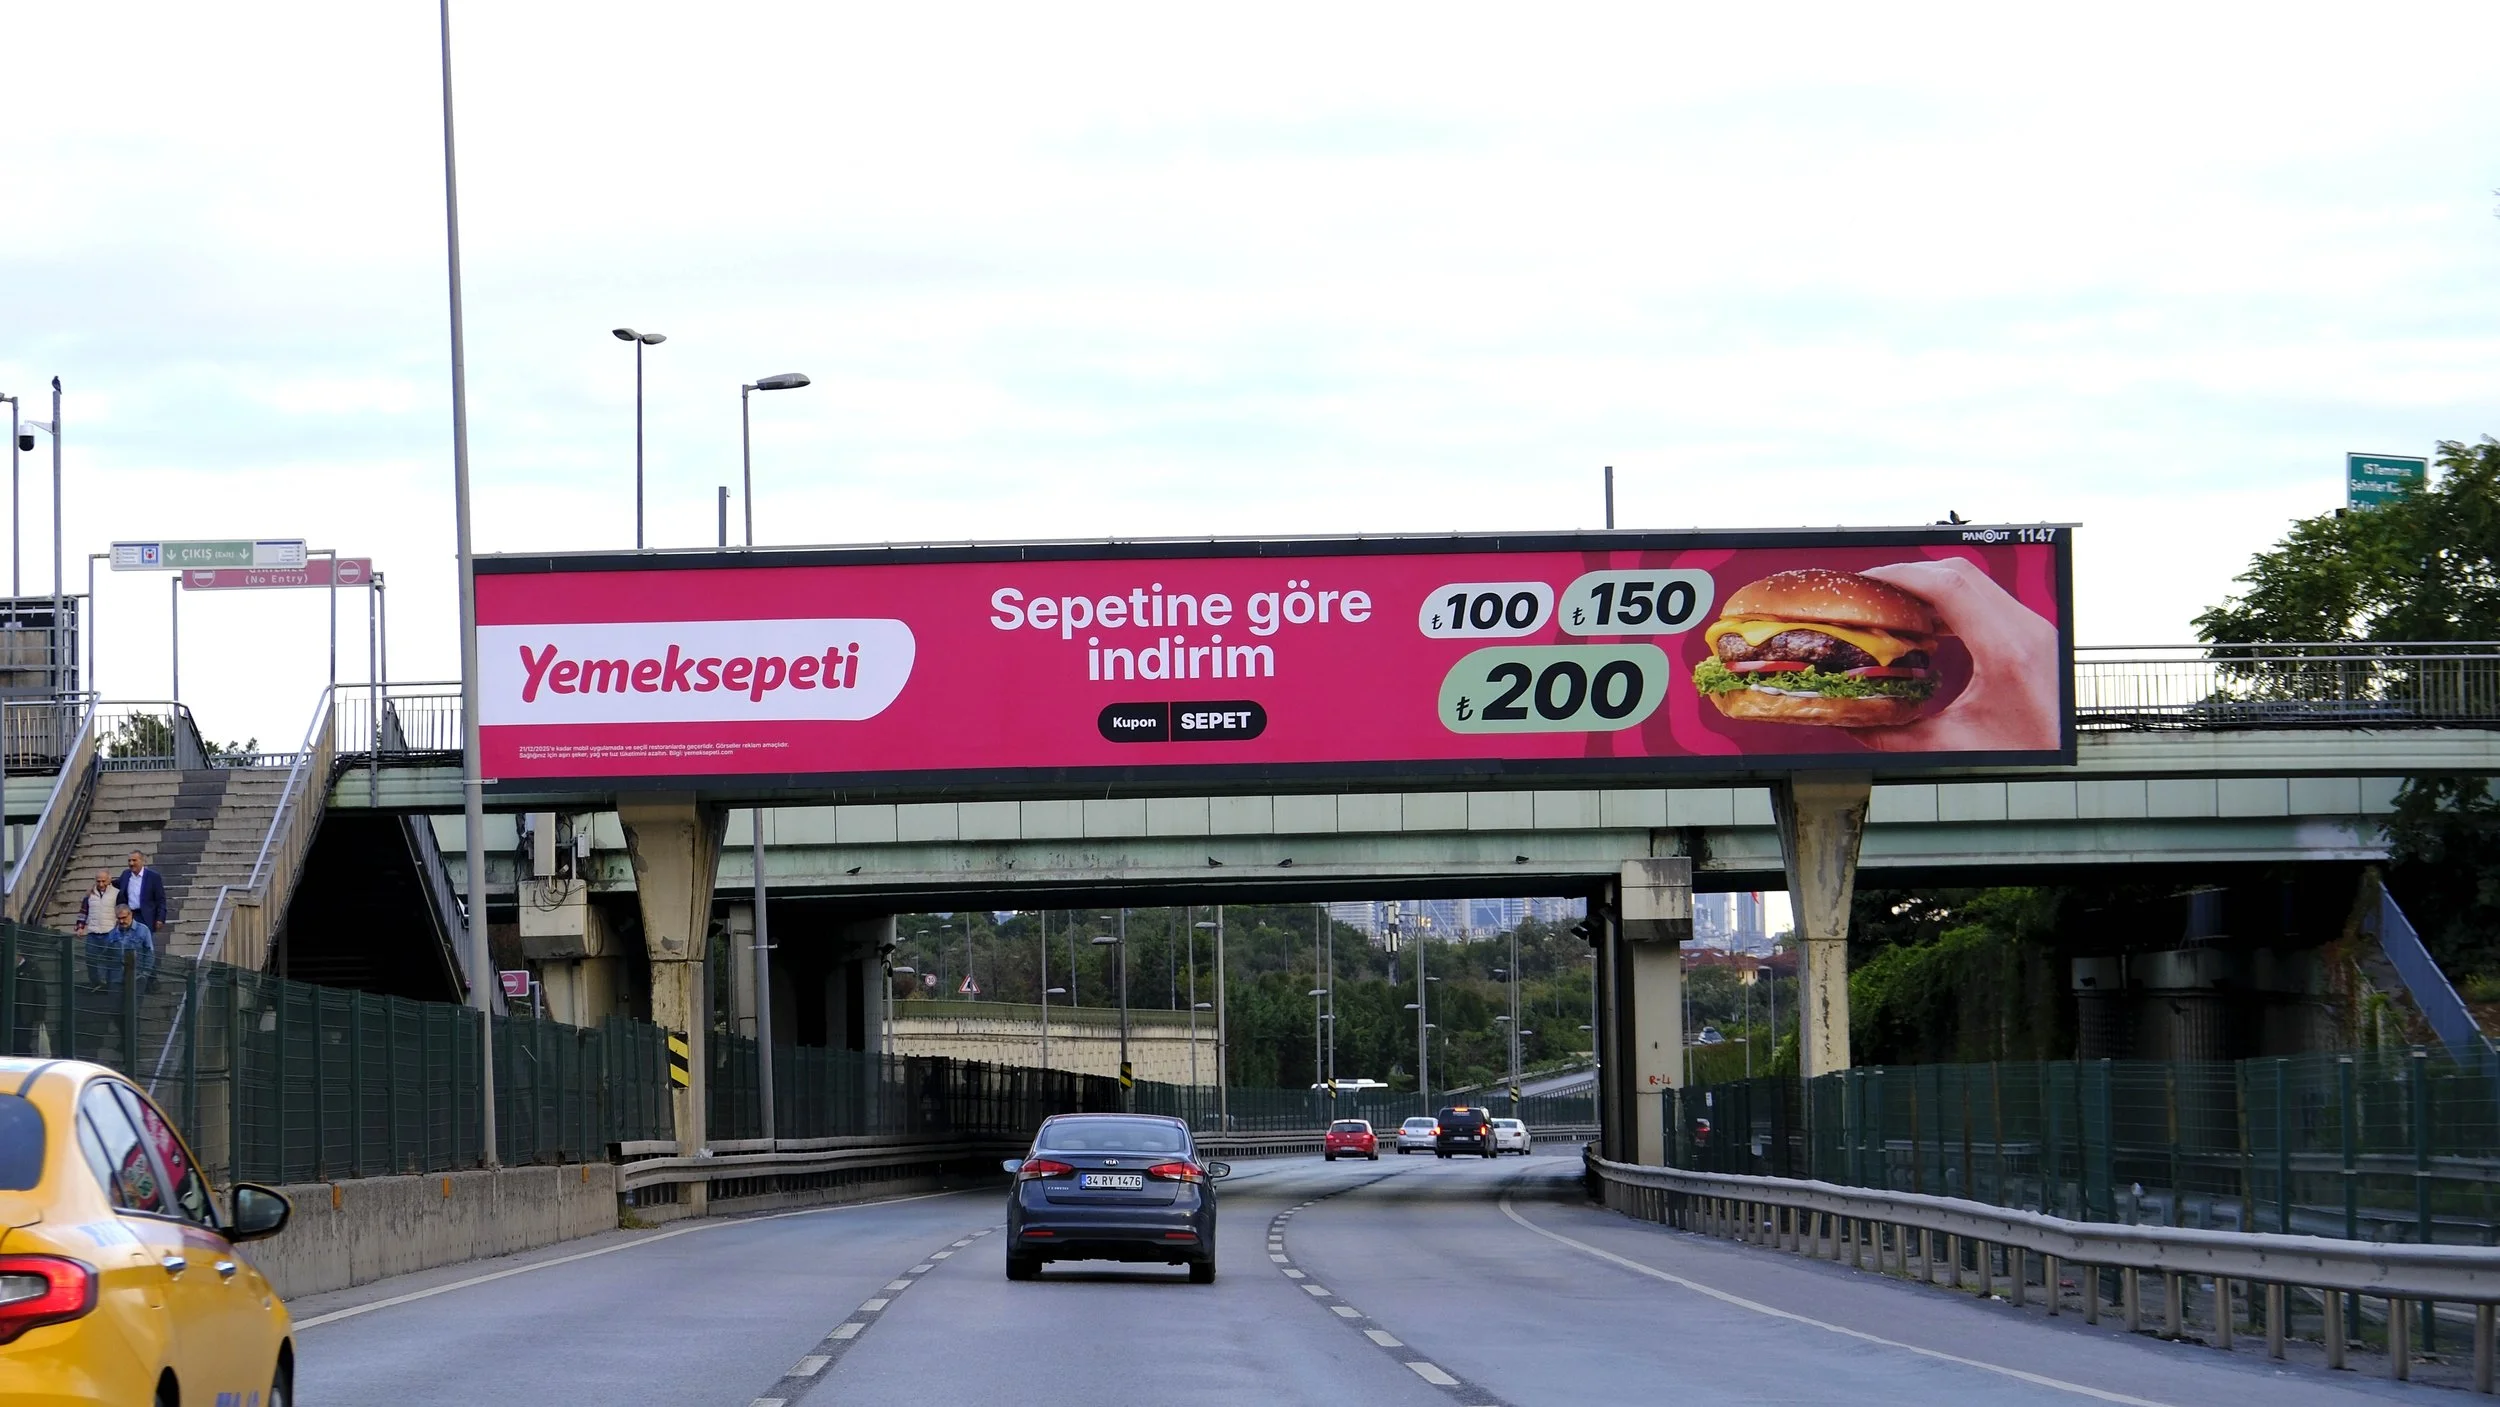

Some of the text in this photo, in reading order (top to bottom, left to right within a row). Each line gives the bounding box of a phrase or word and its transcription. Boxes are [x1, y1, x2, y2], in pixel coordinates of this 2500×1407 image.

[2018, 528, 2056, 542] 1147
[182, 548, 212, 560] ÇIKIŞ
[245, 573, 308, 585] (No Entry)
[990, 579, 1372, 640] Sepetine göre
[1088, 634, 1275, 681] indirim
[519, 642, 860, 703] Yemeksepeti
[1113, 711, 1251, 730] Kupon SEPET
[1087, 1176, 1141, 1186] 34 RY 1476
